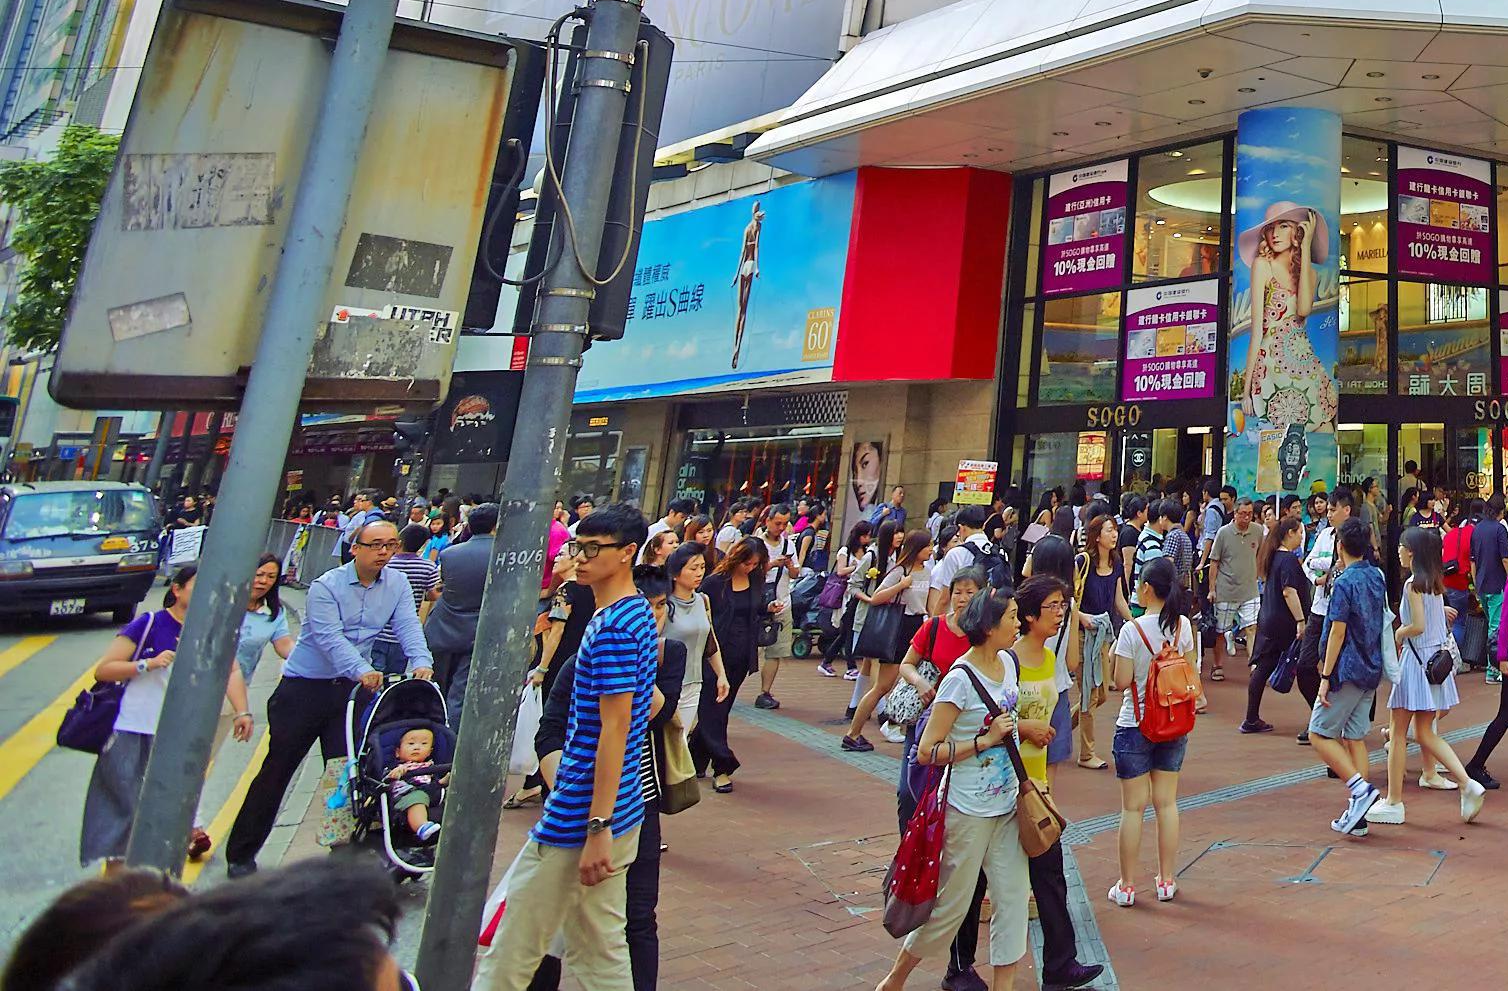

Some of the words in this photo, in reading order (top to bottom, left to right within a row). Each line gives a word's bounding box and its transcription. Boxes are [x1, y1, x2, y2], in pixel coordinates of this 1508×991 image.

[1408, 242, 1481, 265] 10%現金回贈
[808, 320, 829, 351] 60
[1134, 371, 1206, 393] 10%現金回贈
[1087, 404, 1142, 427] SOGO
[1261, 432, 1283, 442] CASIO
